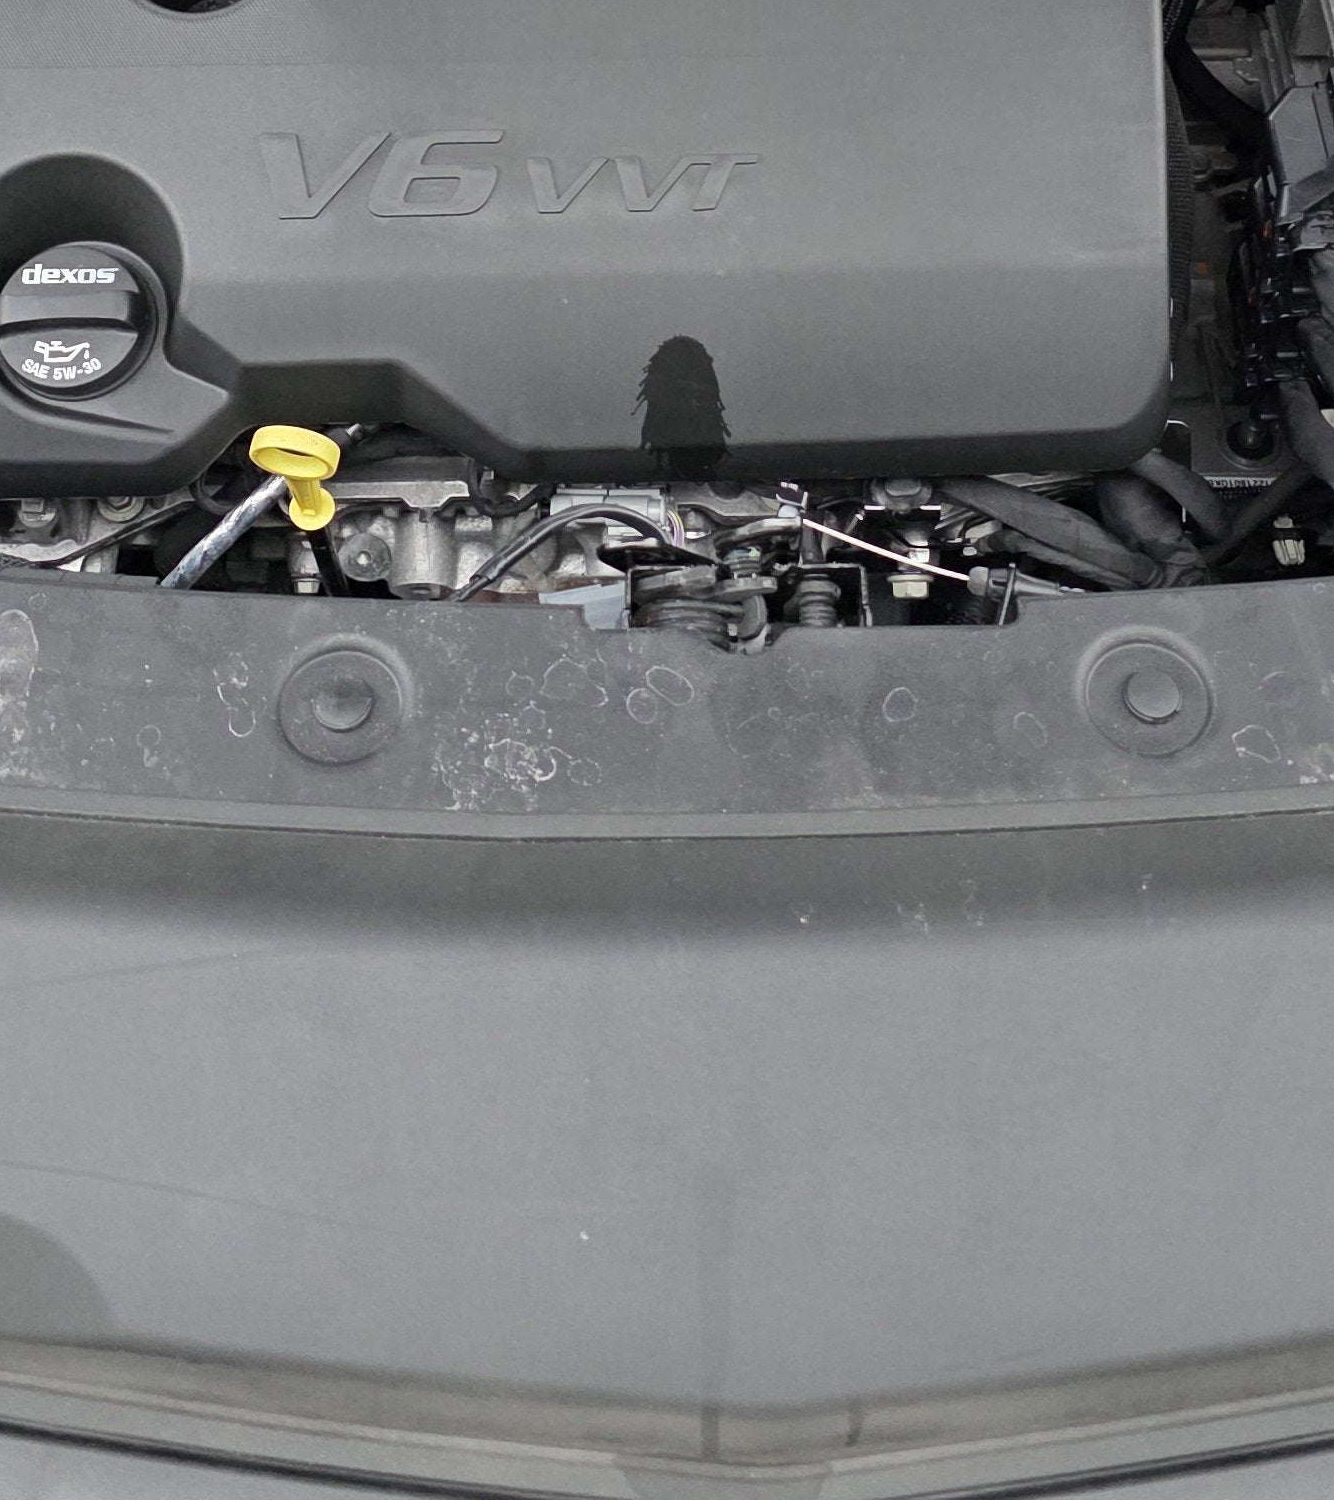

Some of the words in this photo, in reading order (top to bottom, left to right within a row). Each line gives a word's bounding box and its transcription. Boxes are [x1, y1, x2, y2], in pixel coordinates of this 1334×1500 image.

[260, 128, 505, 220] V6
[525, 154, 761, 215] VVT
[21, 263, 119, 284] dexos
[22, 358, 50, 379] SAE
[52, 357, 102, 380] 5W-30
